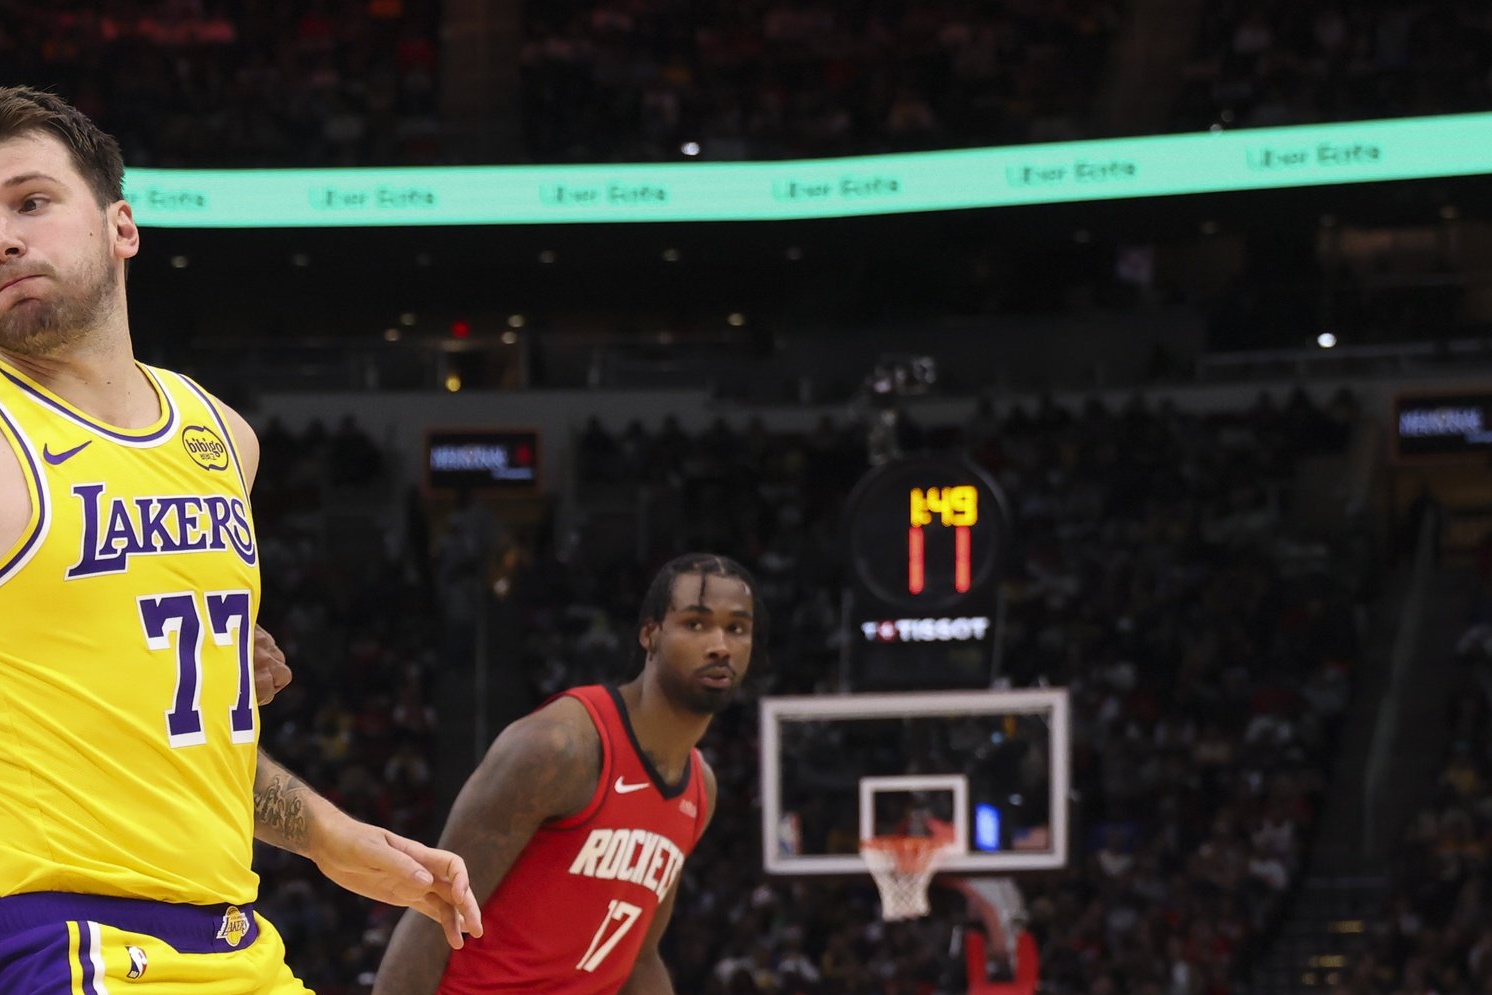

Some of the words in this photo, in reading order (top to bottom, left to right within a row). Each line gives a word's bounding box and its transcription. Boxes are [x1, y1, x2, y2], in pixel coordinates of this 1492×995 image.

[185, 437, 224, 458] bibigo
[64, 481, 259, 581] LAKERS
[136, 590, 256, 748] 77
[575, 899, 643, 973] 17
